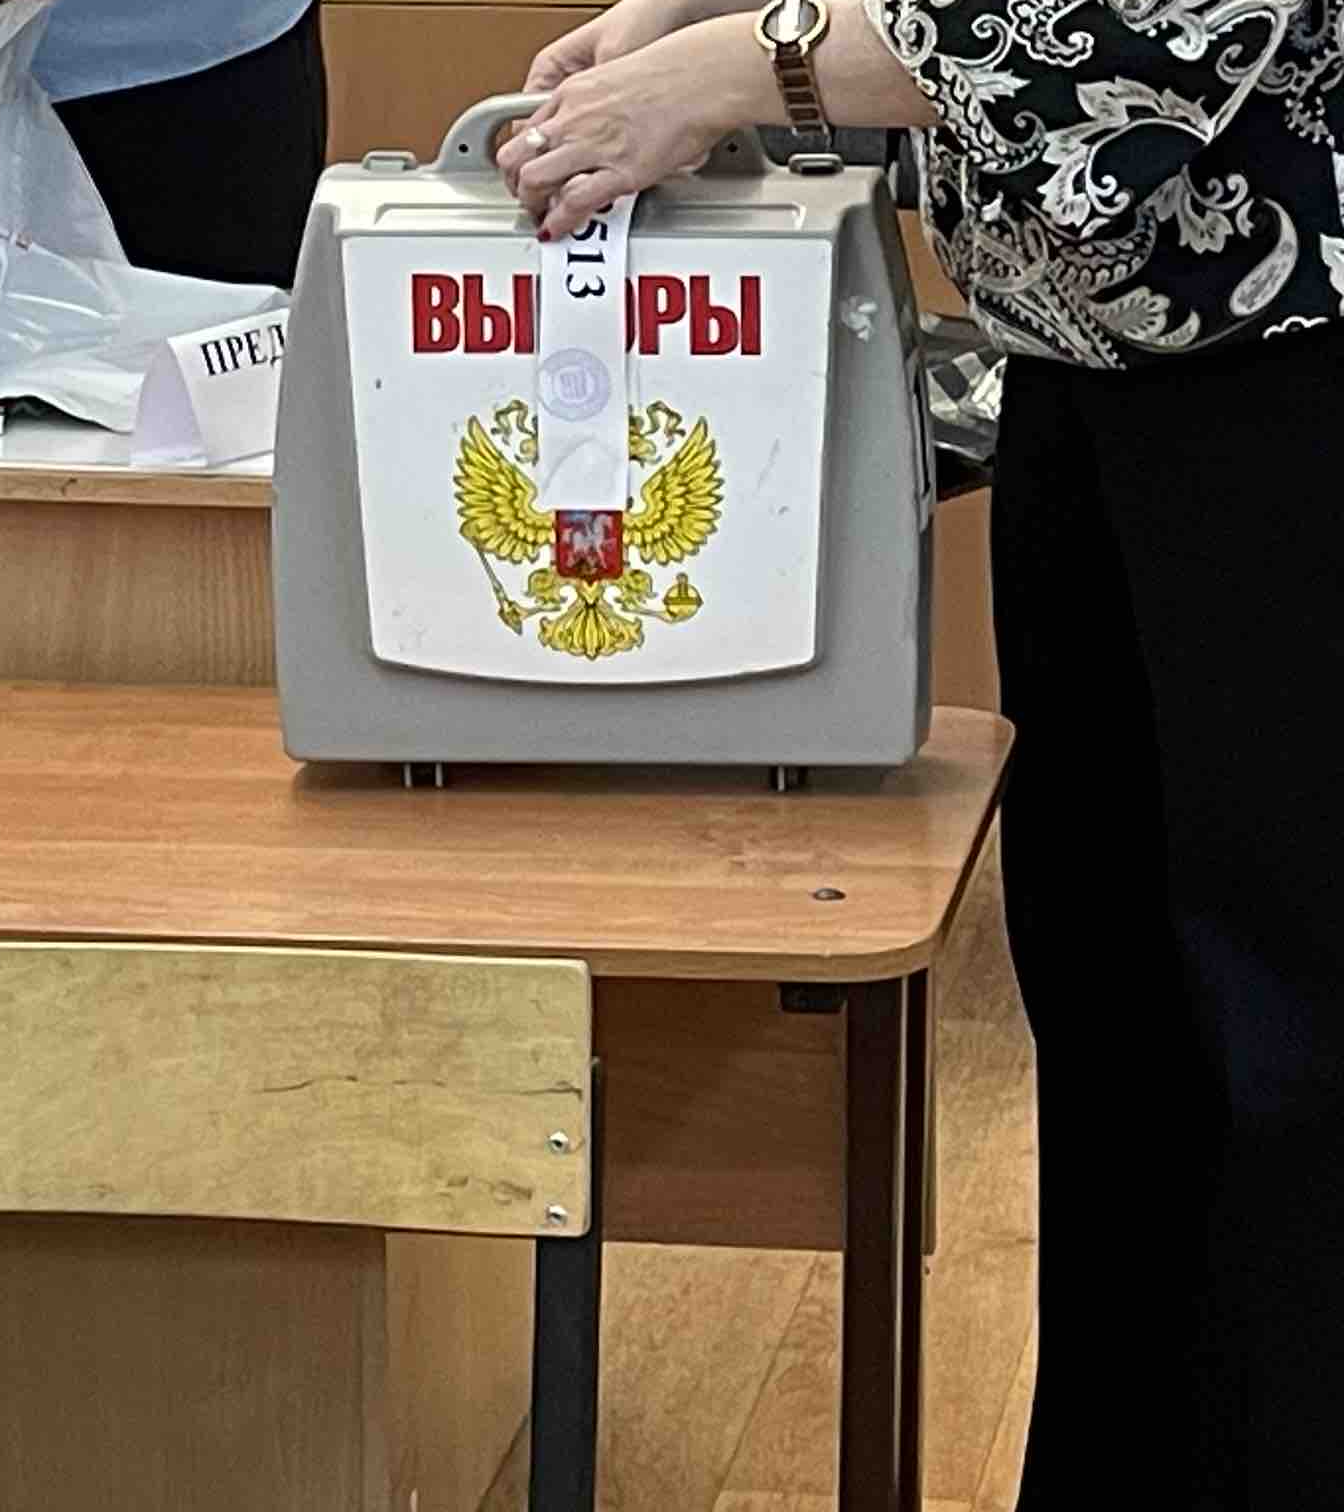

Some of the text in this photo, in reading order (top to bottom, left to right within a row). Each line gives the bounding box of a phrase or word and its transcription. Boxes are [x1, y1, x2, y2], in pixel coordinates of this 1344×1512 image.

[566, 202, 614, 299] 513
[200, 324, 287, 376] ПРЕД
[411, 273, 762, 356] ВЫРЫ
